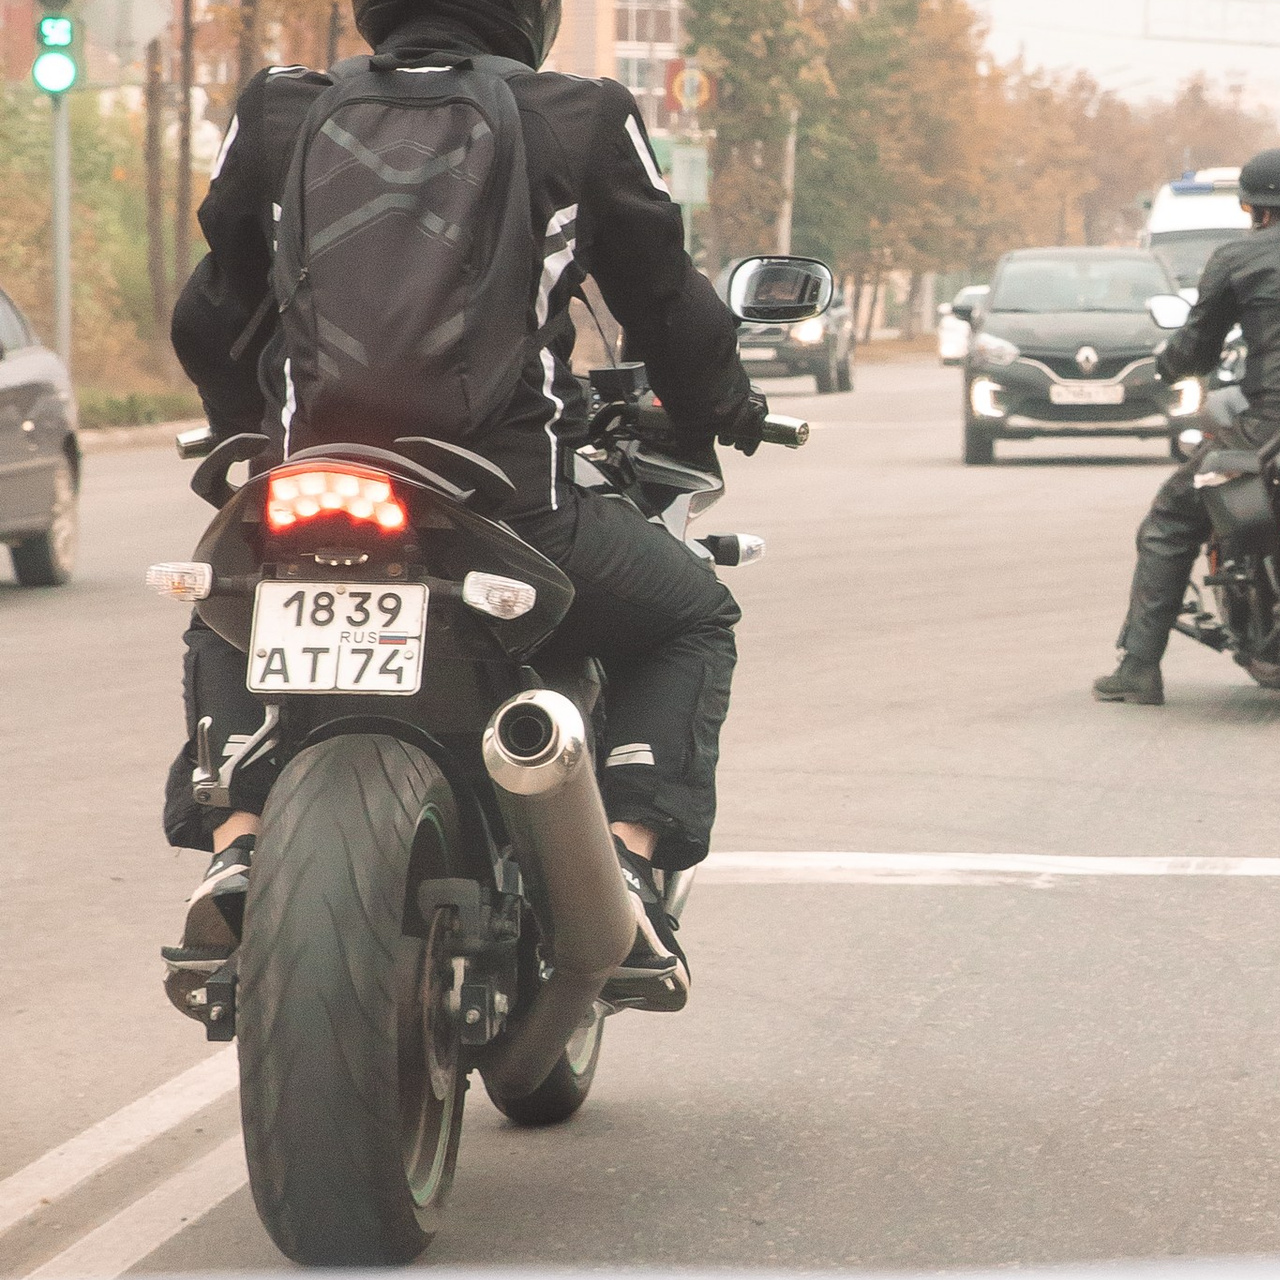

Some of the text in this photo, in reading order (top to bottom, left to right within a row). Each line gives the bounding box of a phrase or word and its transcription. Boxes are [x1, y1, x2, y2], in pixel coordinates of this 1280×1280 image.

[283, 590, 402, 628] 1839
[340, 631, 377, 644] RUS
[259, 647, 404, 685] AT 74
